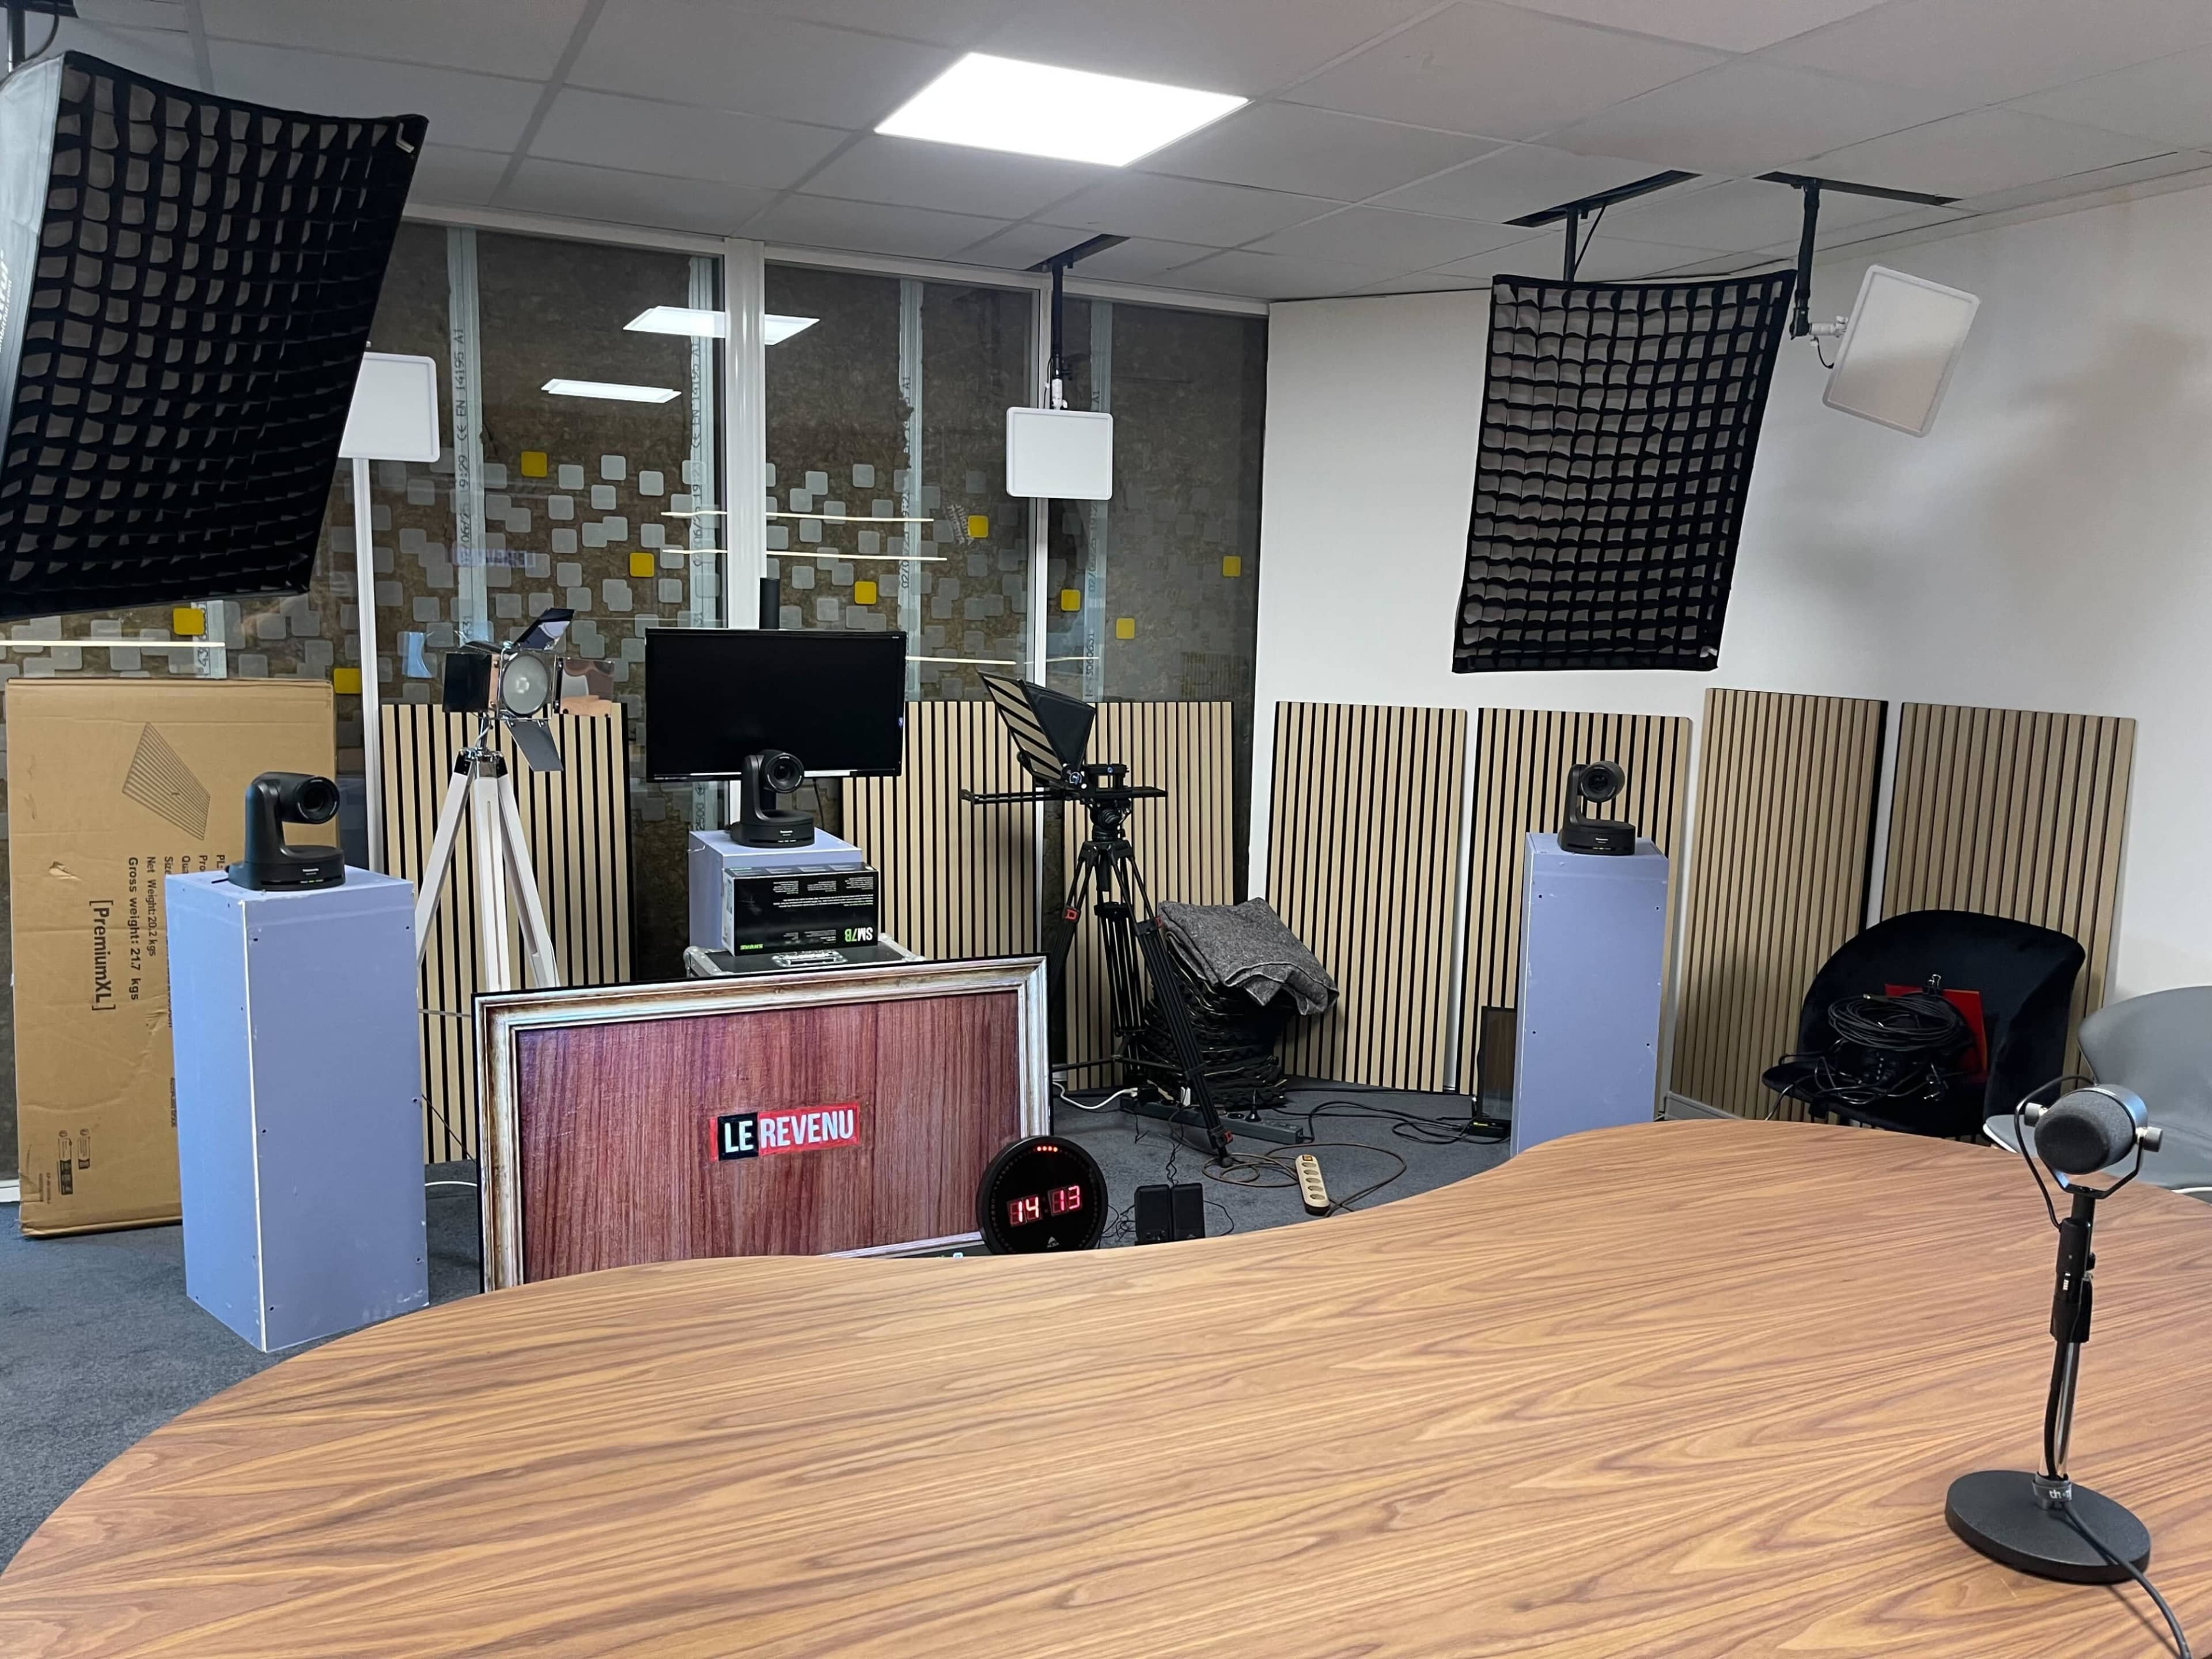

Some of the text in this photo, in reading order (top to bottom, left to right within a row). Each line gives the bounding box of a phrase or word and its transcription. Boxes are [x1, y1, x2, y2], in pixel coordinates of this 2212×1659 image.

[452, 328, 464, 344] A1
[454, 351, 466, 392] 14195
[456, 399, 467, 417] EN
[146, 856, 156, 873] Net
[127, 857, 141, 1001] Gross weight: 21.7 kgs
[844, 926, 874, 942] SM7B
[146, 939, 158, 956] kgs
[724, 1109, 854, 1153] LE REVENU
